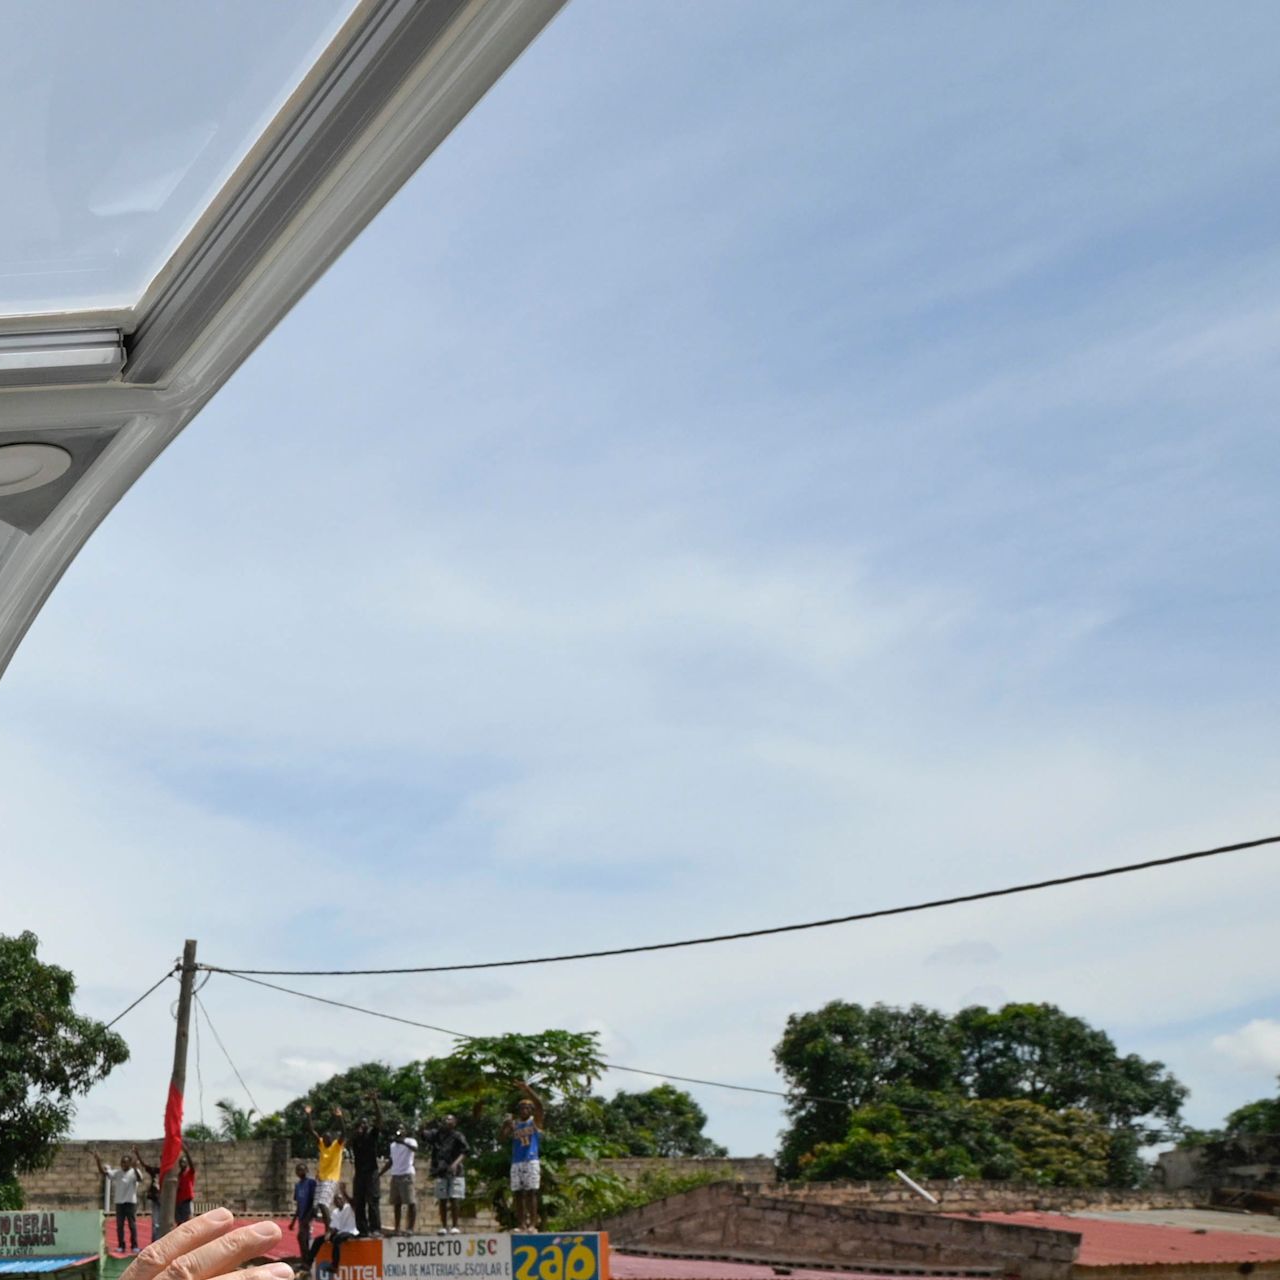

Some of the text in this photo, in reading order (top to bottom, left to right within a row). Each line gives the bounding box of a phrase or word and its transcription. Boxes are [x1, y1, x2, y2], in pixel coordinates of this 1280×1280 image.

[14, 1212, 58, 1235] GERAL
[397, 1239, 497, 1258] PROJECTO JSC
[384, 1262, 510, 1277] VENDA DE MATERIAIS ESCOLAR E
